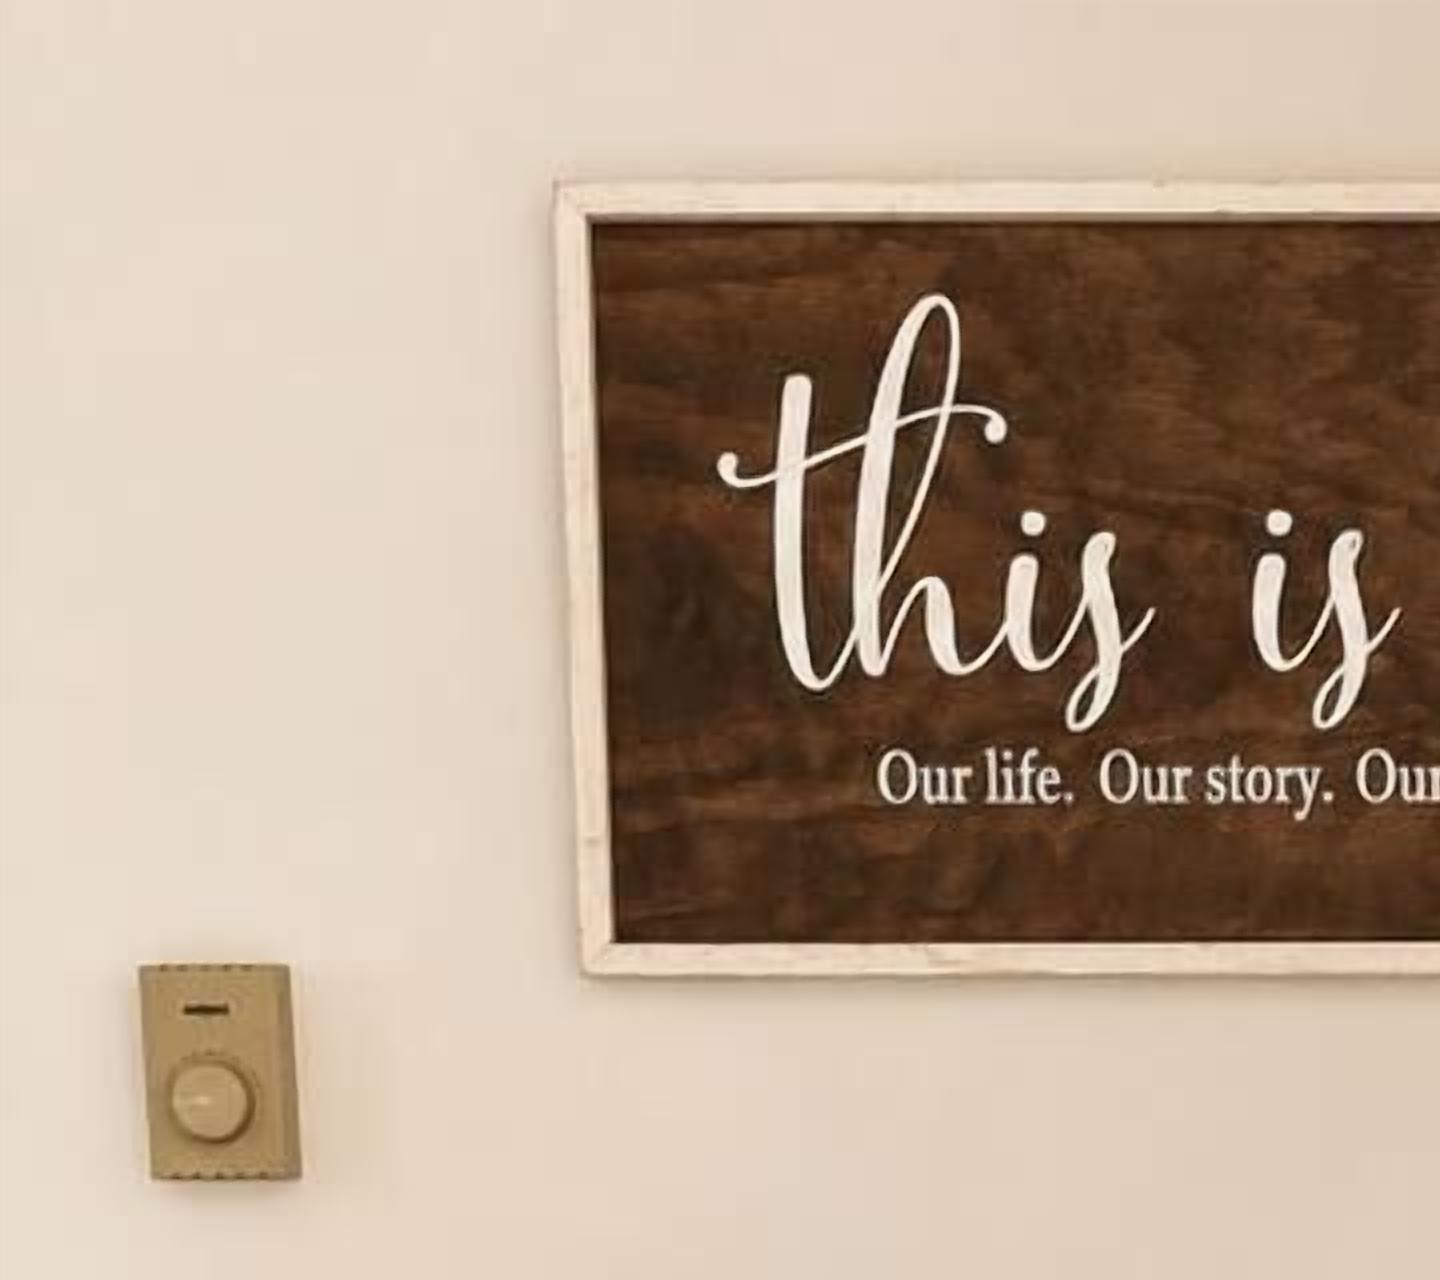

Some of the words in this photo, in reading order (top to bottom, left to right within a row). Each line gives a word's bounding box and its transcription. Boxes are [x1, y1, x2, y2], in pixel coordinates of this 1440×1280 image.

[717, 294, 1155, 732] this
[1252, 509, 1401, 729] is
[877, 748, 973, 804] Our
[984, 747, 1074, 804] life.
[1098, 748, 1193, 804] Our
[1206, 755, 1334, 821] story.
